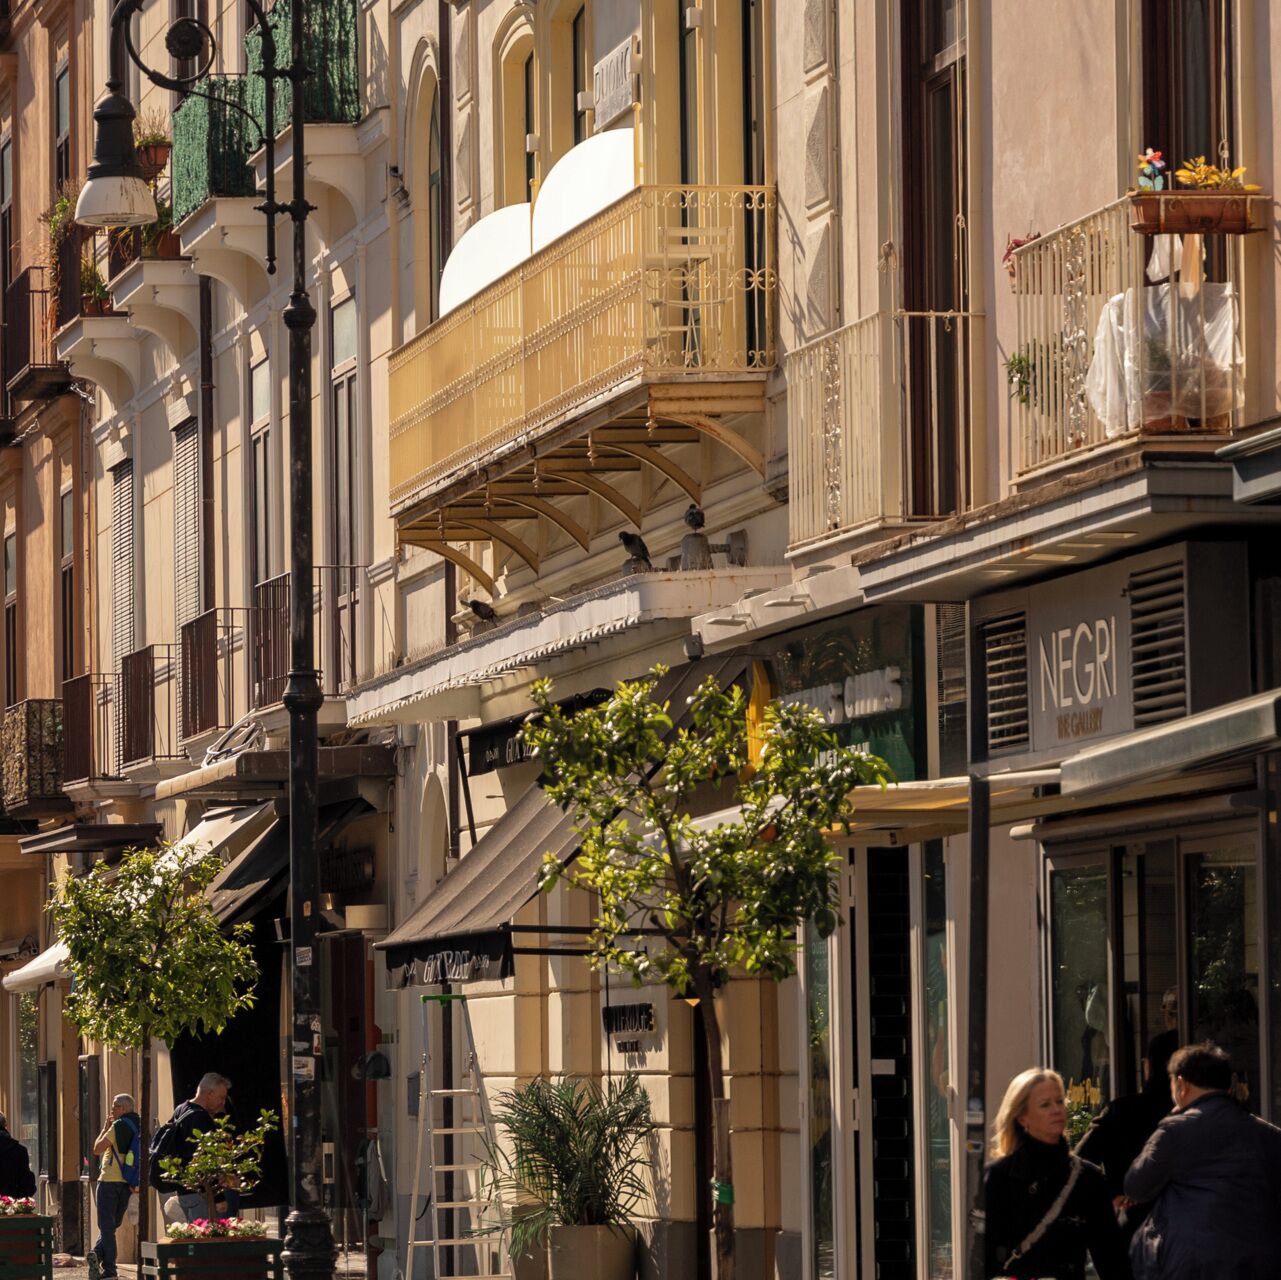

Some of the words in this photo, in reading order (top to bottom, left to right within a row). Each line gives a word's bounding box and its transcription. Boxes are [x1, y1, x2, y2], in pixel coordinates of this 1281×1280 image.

[1039, 616, 1117, 711] NEGRI
[1056, 712, 1070, 740] THE
[1071, 707, 1104, 737] GALLERY
